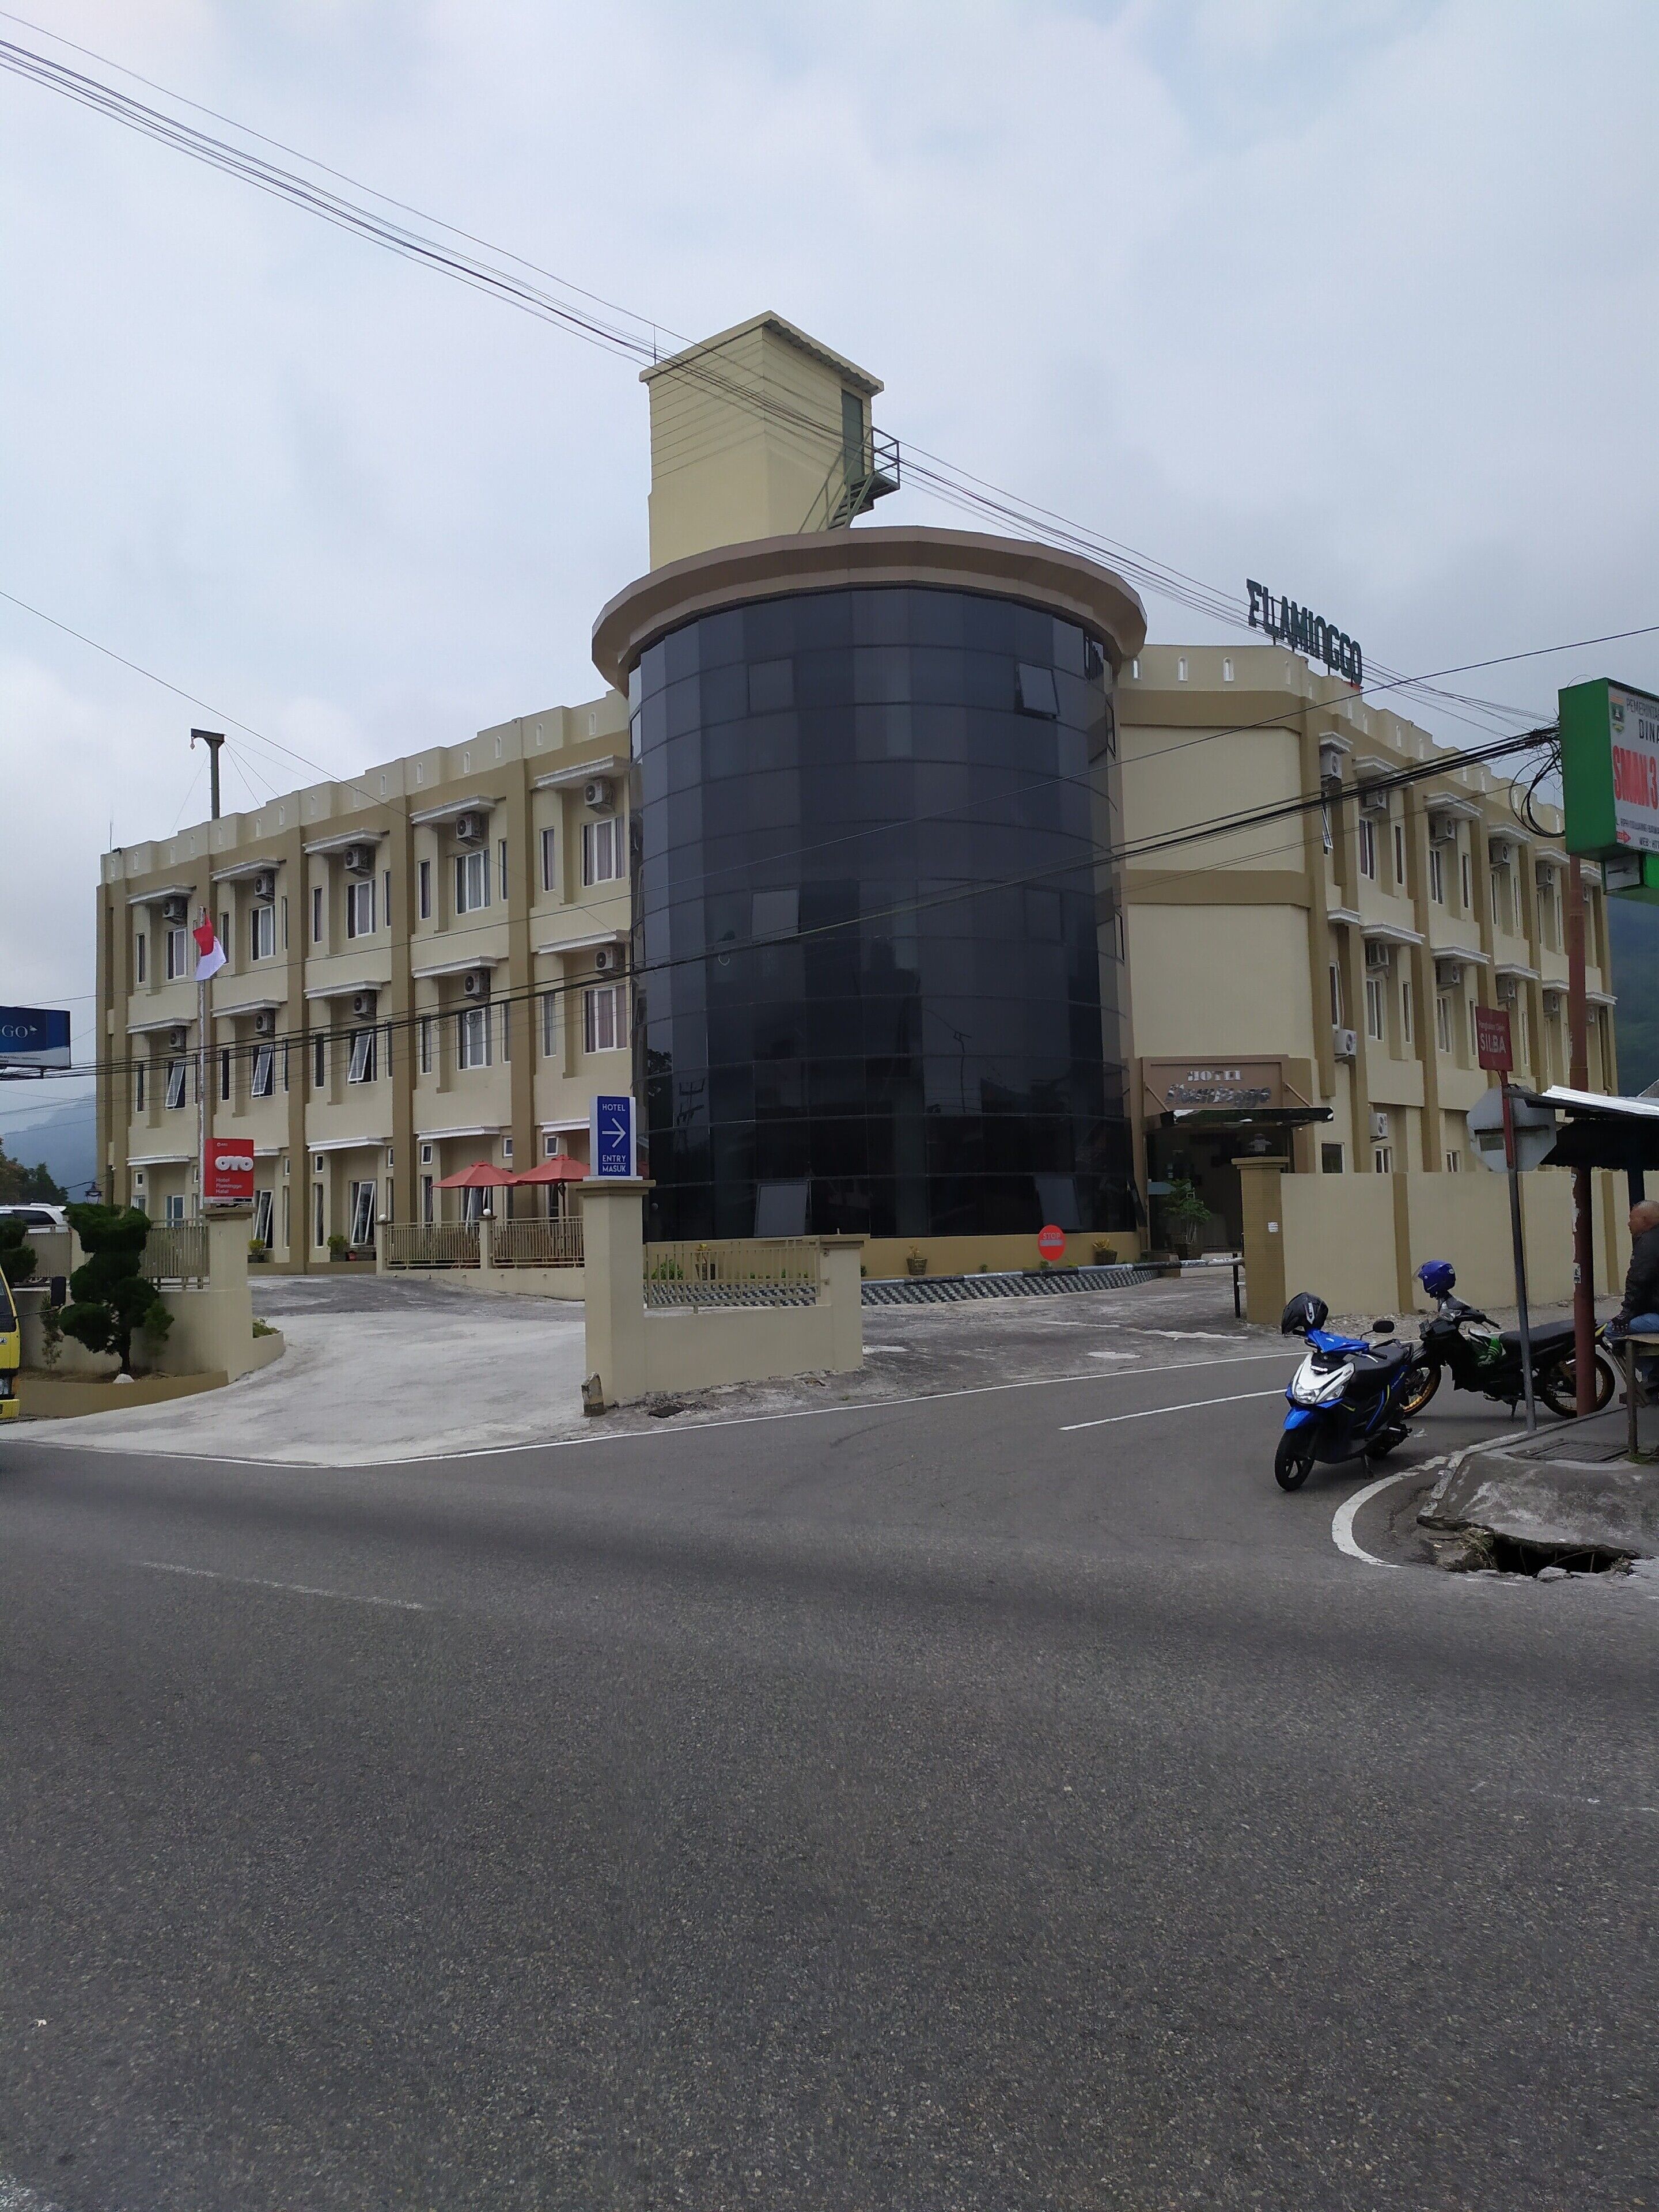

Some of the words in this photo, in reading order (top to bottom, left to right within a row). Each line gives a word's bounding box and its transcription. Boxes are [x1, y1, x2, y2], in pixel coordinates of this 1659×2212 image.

[1246, 578, 1362, 685] FLAMINGGO
[1187, 1070, 1241, 1082] HOTEL
[602, 1104, 626, 1112] HOTEL
